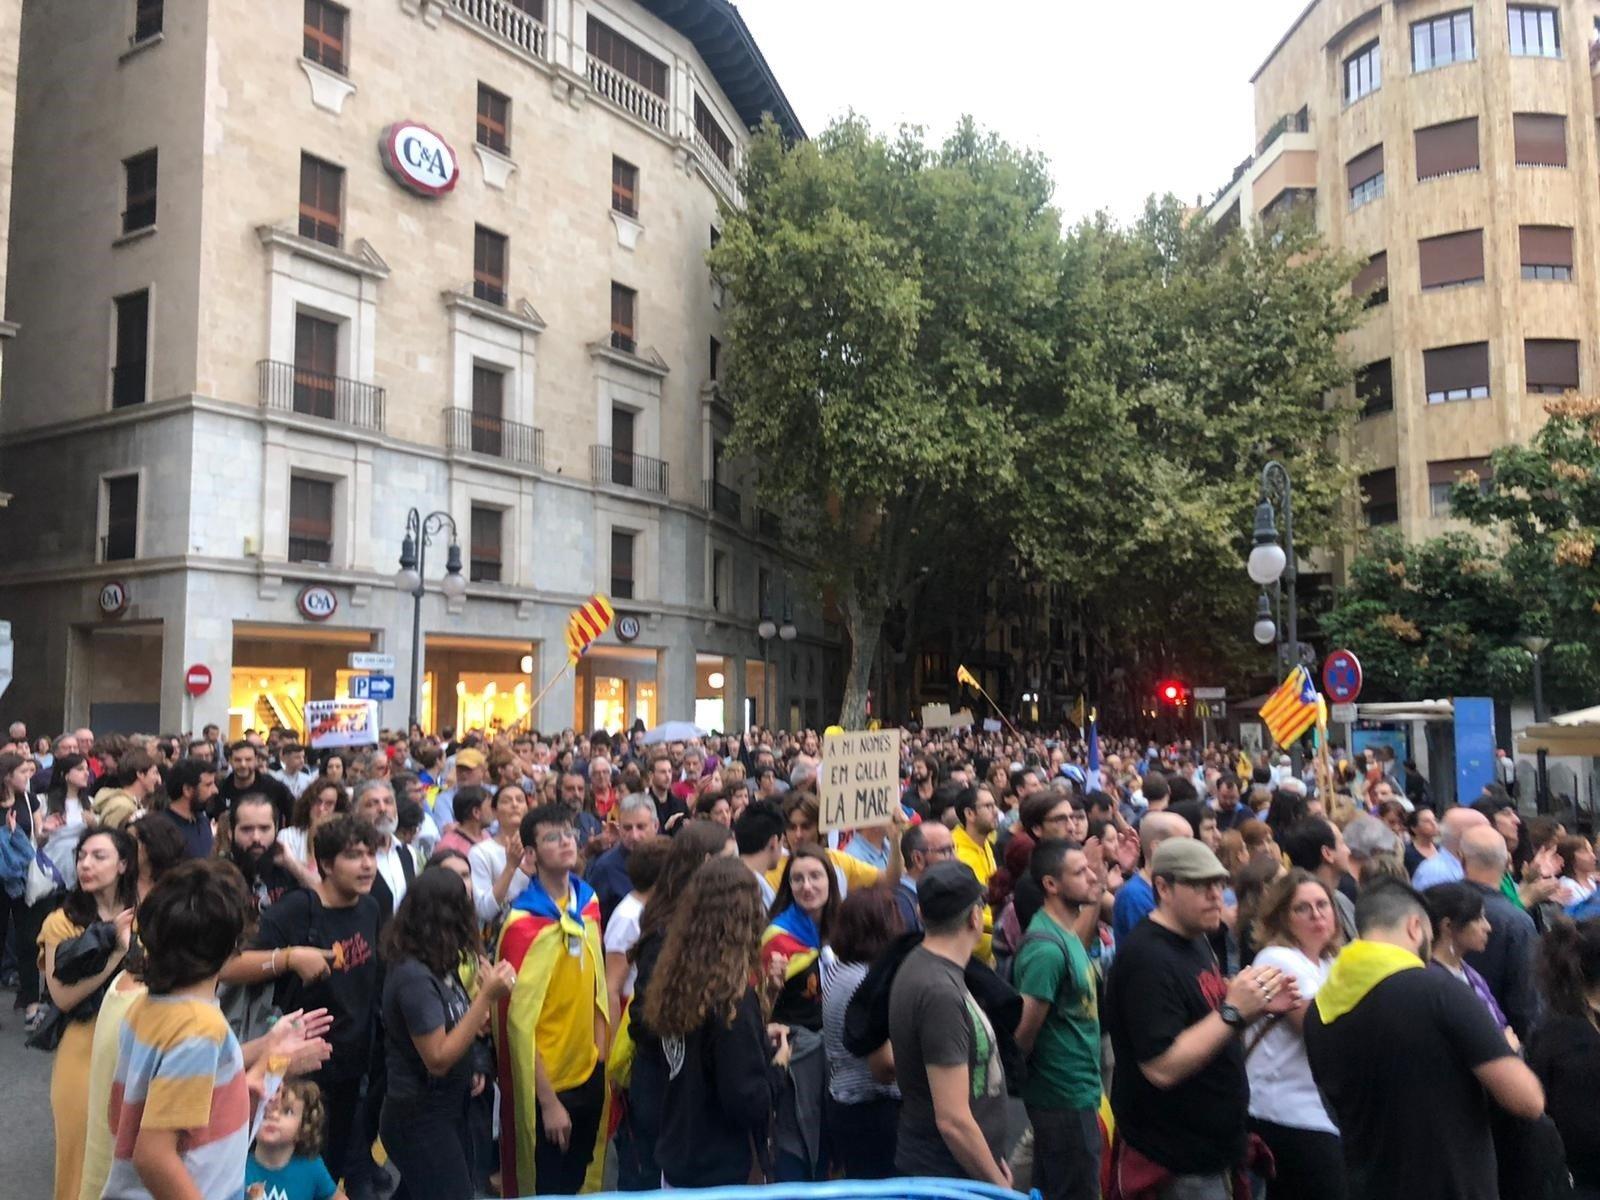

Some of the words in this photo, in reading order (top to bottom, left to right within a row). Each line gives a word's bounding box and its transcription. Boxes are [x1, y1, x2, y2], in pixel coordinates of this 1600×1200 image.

[403, 137, 448, 180] C&A
[357, 680, 367, 696] P
[828, 740, 836, 757] A
[843, 739, 855, 755] MI
[831, 763, 849, 785] EM
[855, 759, 888, 781] CALLA
[826, 791, 846, 825] LA
[855, 786, 891, 820] MARE
